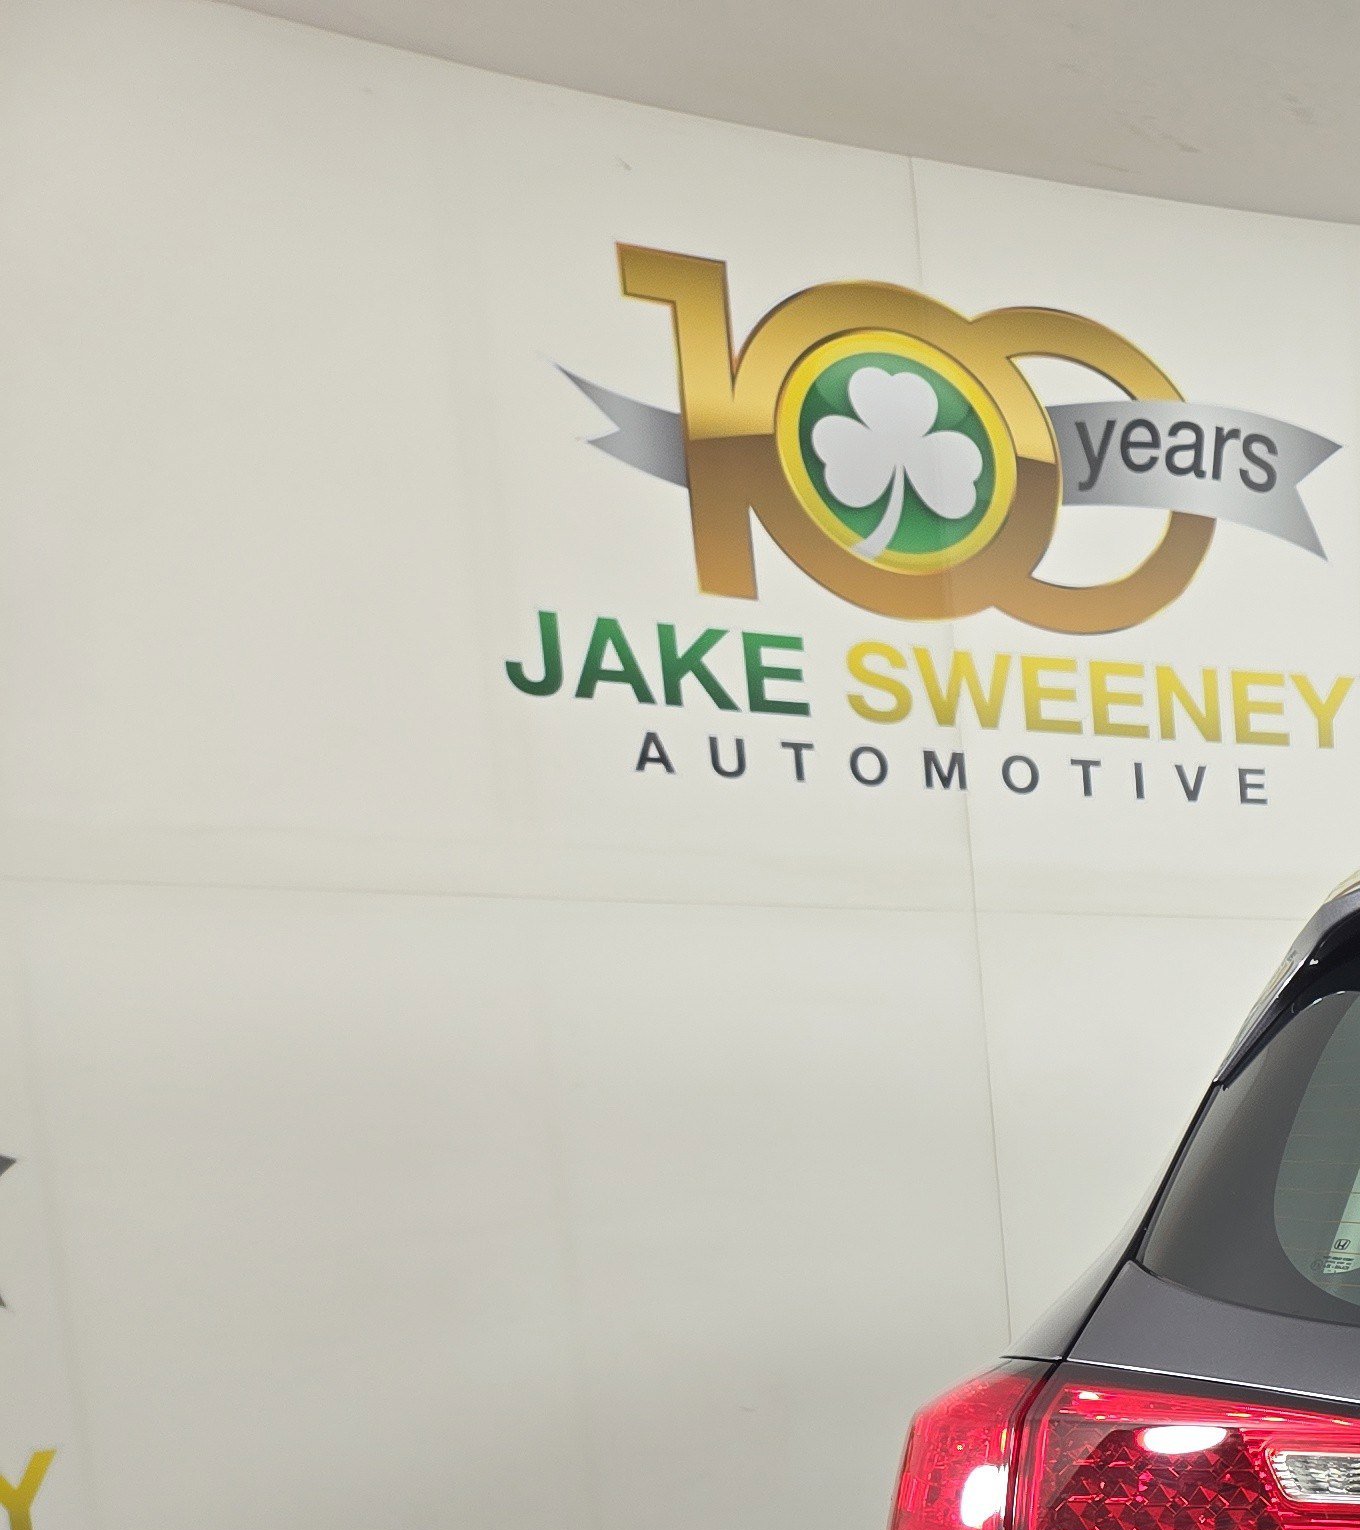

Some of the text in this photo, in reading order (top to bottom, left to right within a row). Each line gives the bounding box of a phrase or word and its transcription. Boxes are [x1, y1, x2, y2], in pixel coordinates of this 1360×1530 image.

[615, 242, 1279, 634] 100 years
[505, 610, 1356, 750] JAKE SWEENEY
[634, 731, 1269, 806] AUTOMOTIVE
